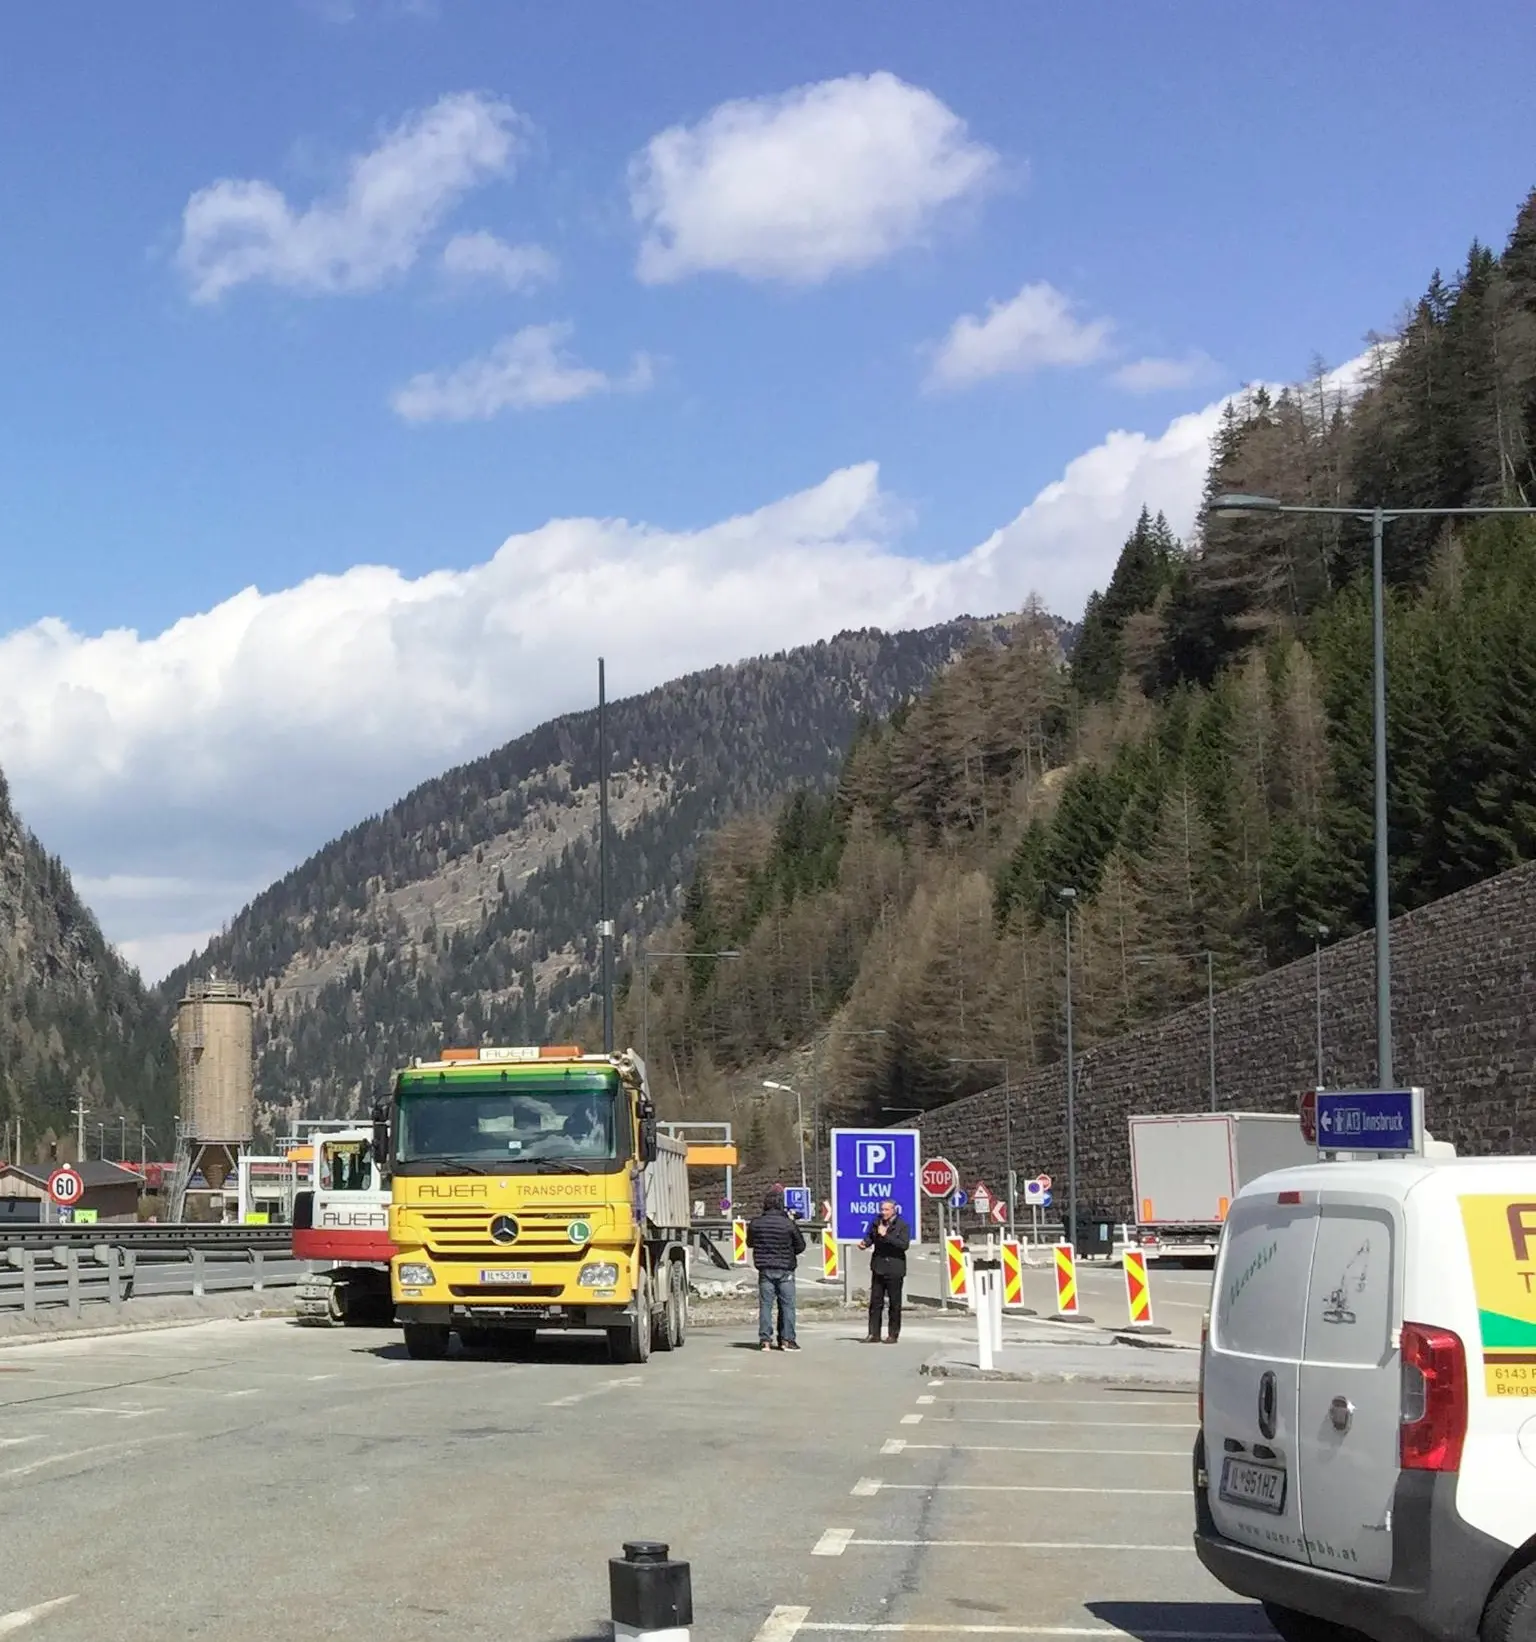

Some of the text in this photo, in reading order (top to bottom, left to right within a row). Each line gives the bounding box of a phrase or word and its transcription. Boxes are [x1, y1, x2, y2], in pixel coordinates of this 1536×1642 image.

[1362, 1111, 1404, 1131] Innsbruck
[866, 1144, 887, 1174] P
[923, 1171, 952, 1185] STOP
[56, 1177, 74, 1196] 60
[418, 1184, 597, 1198] AUER TRANSPORTE
[859, 1183, 892, 1197] LKW
[323, 1212, 386, 1226] AUER
[574, 1225, 585, 1240] L
[1495, 1368, 1527, 1379] 6143
